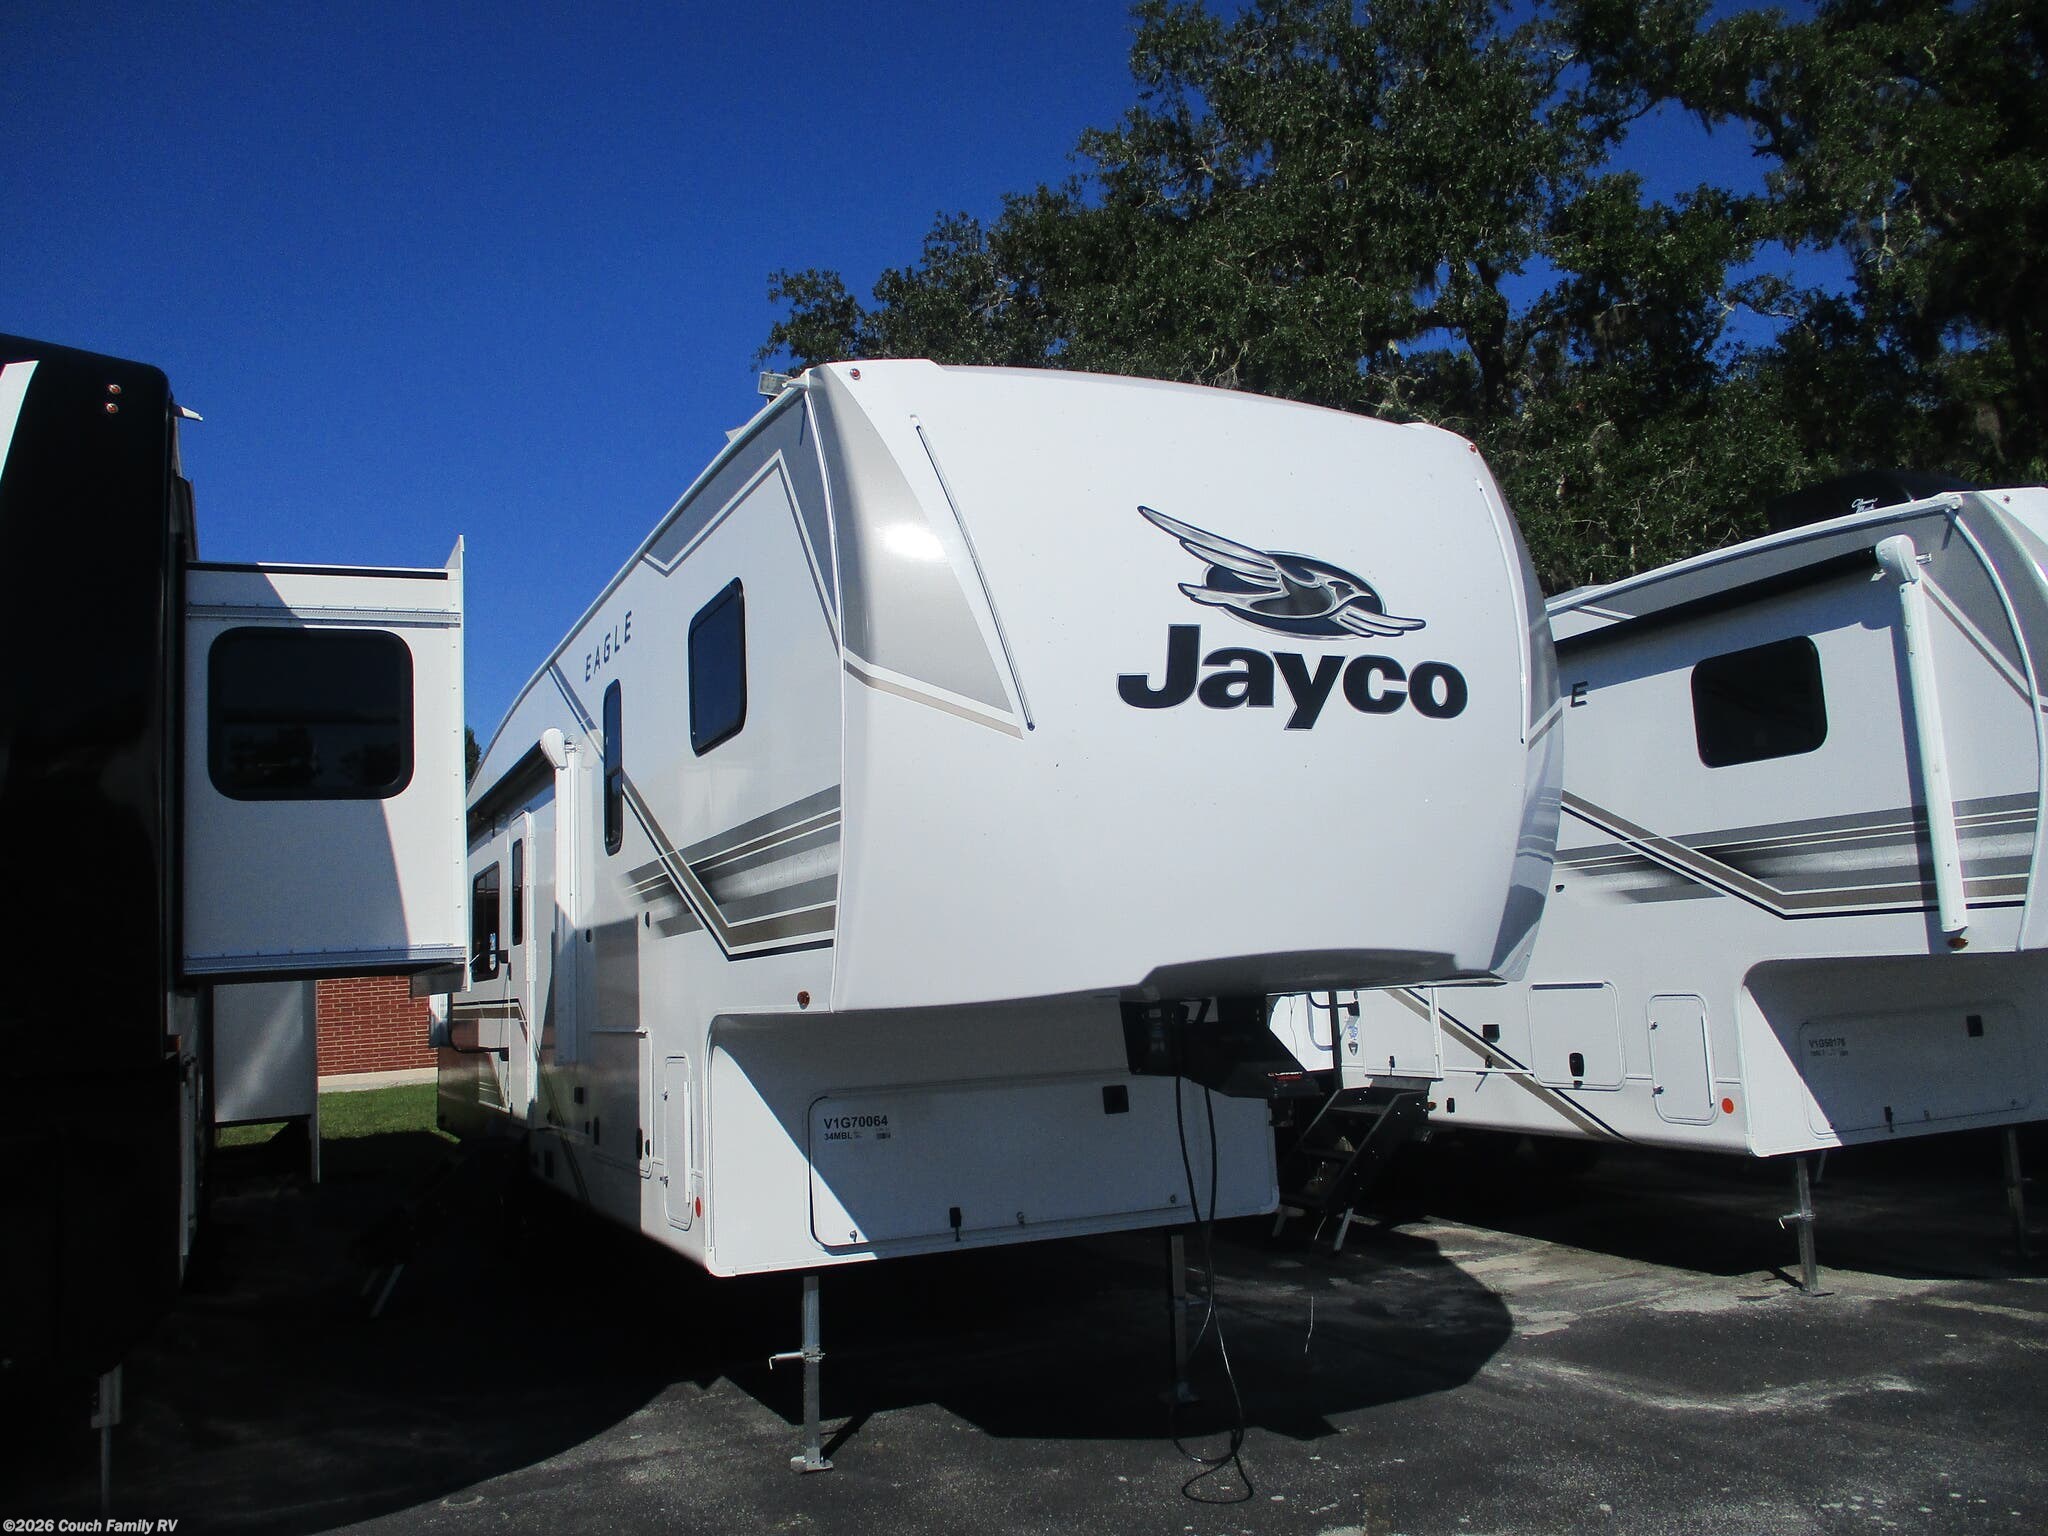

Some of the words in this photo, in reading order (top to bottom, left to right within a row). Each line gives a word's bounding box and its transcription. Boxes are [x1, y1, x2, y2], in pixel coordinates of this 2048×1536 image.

[585, 610, 632, 682] EAGLE
[1116, 623, 1469, 732] Jayco
[823, 1115, 889, 1130] V1G70064
[824, 1131, 853, 1141] 34MBL
